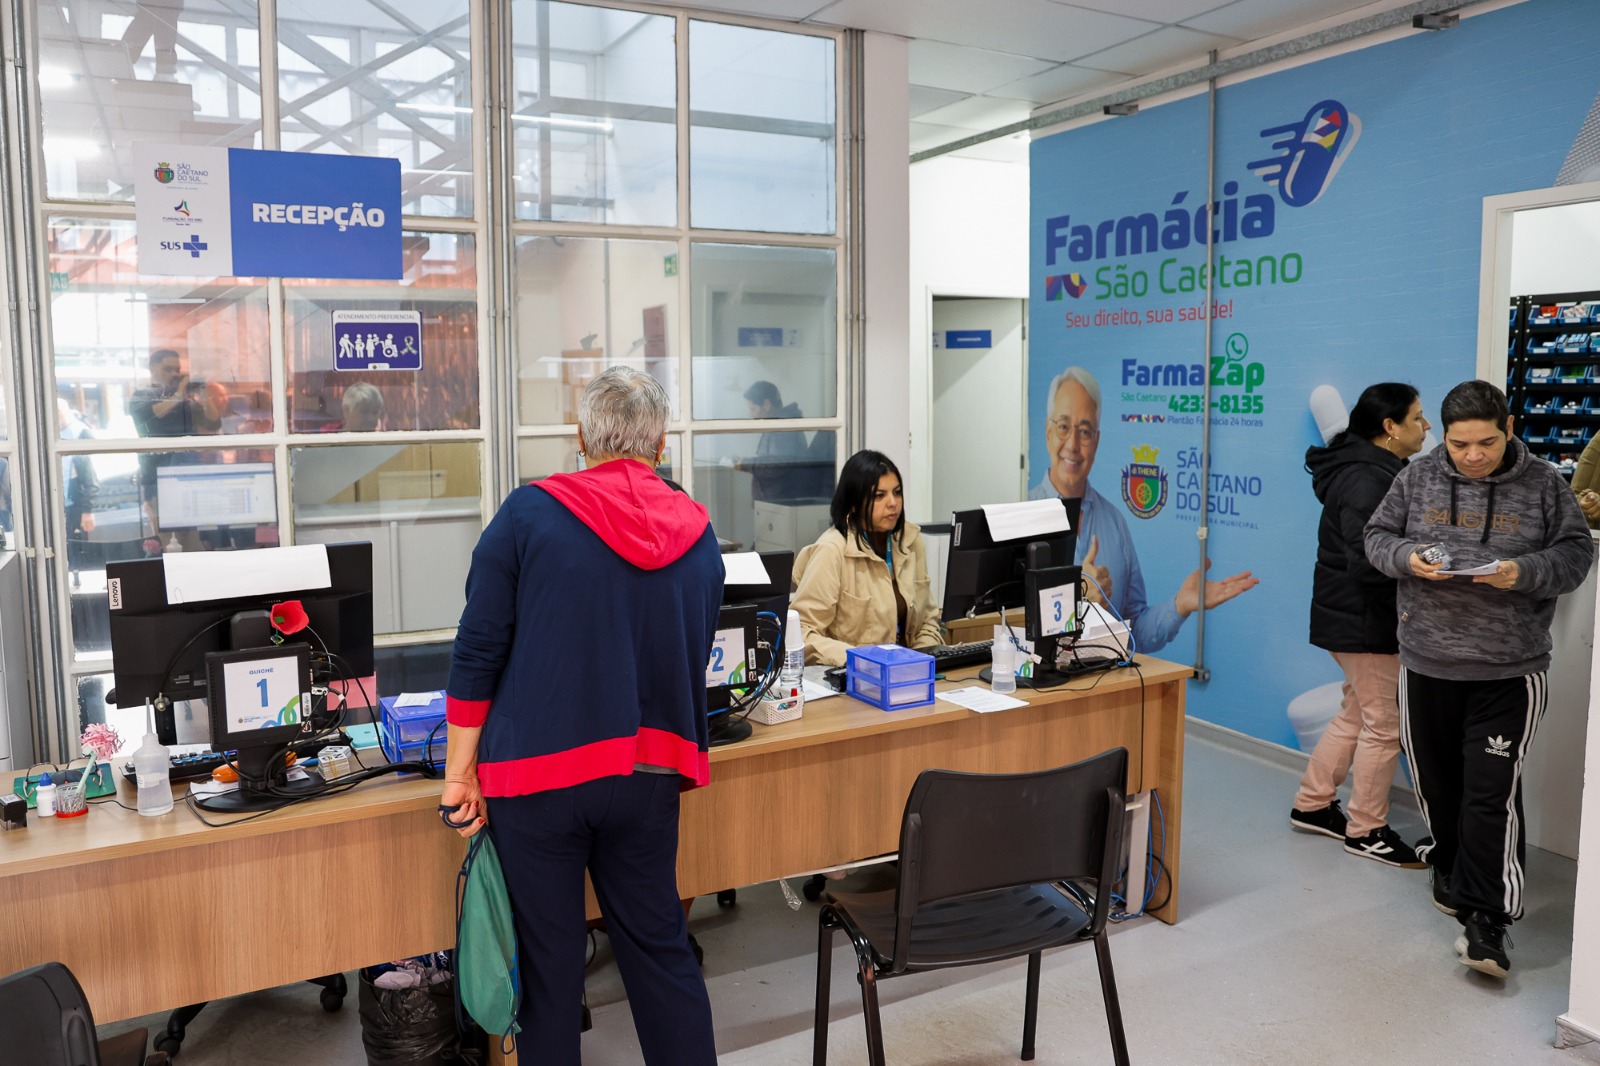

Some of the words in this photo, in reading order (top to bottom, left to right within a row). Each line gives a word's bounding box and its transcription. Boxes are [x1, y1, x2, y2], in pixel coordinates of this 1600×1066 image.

[252, 202, 385, 232] RECEPÇÃO
[1046, 181, 1276, 266] Farmácia
[160, 241, 181, 250] SUS
[1095, 263, 1148, 300] São
[1159, 252, 1303, 295] Caetano
[1065, 311, 1090, 328] Seu
[1094, 308, 1142, 327] direito,
[1146, 308, 1173, 323] sua
[1122, 356, 1265, 393] FarmaZap
[1241, 417, 1263, 427] horas
[1177, 492, 1201, 511] DO
[1207, 495, 1240, 516] SUL
[1220, 520, 1259, 530] MUNICIPAL
[1054, 601, 1062, 622] 3
[711, 647, 724, 672] 2
[256, 678, 269, 707] 1
[1485, 747, 1510, 757] adidas
